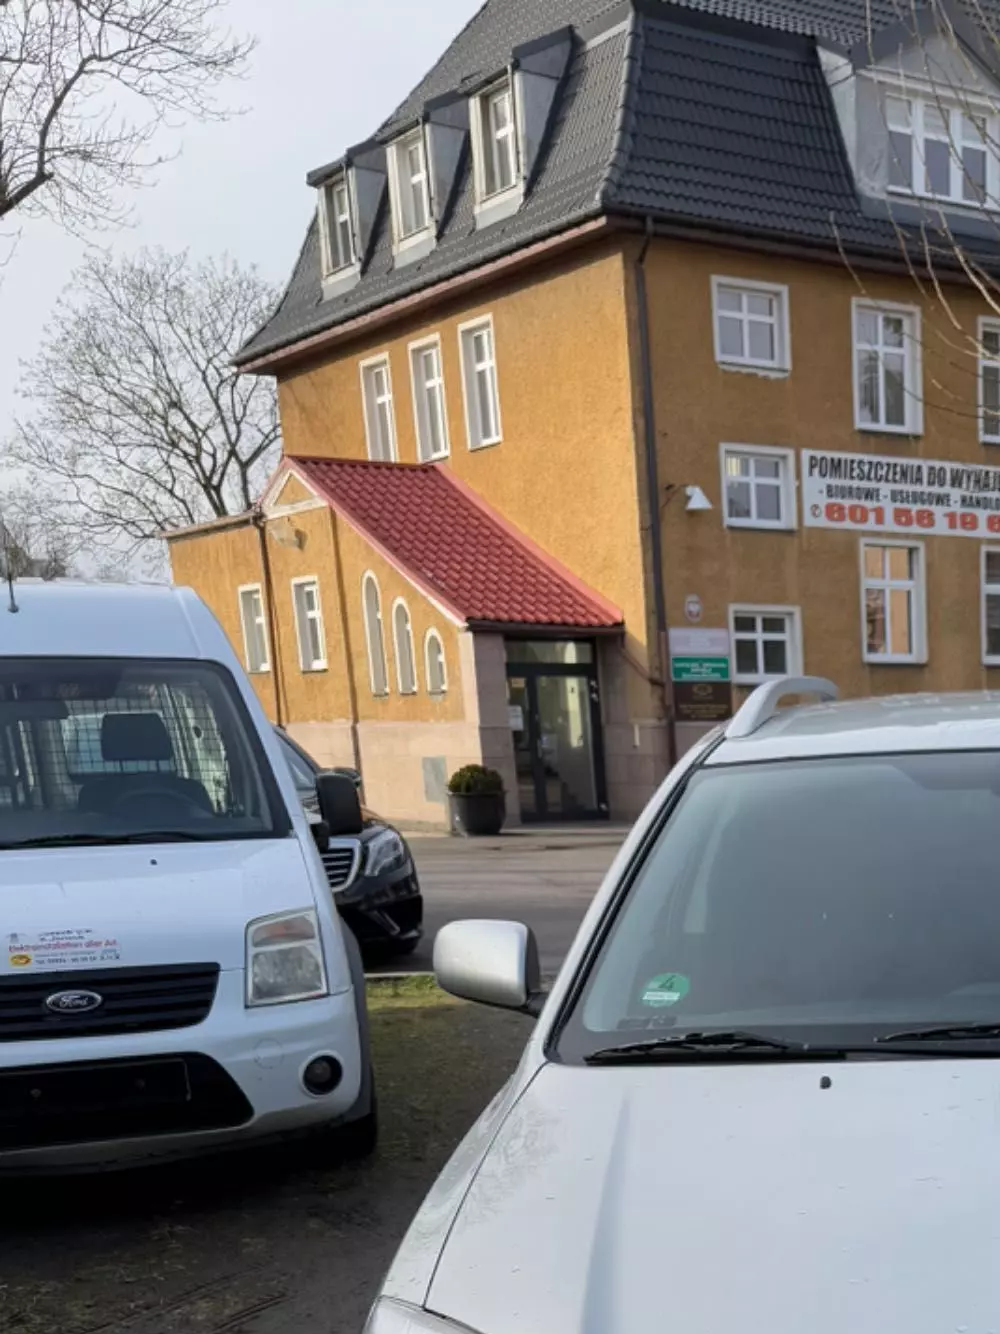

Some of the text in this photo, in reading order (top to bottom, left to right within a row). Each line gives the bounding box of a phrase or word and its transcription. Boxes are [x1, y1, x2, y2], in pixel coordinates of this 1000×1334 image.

[808, 455, 923, 486] POMIESZCZENIA
[927, 466, 947, 487] DO
[824, 502, 885, 526] 601
[893, 506, 936, 529] 56
[58, 994, 89, 1008] Ford
